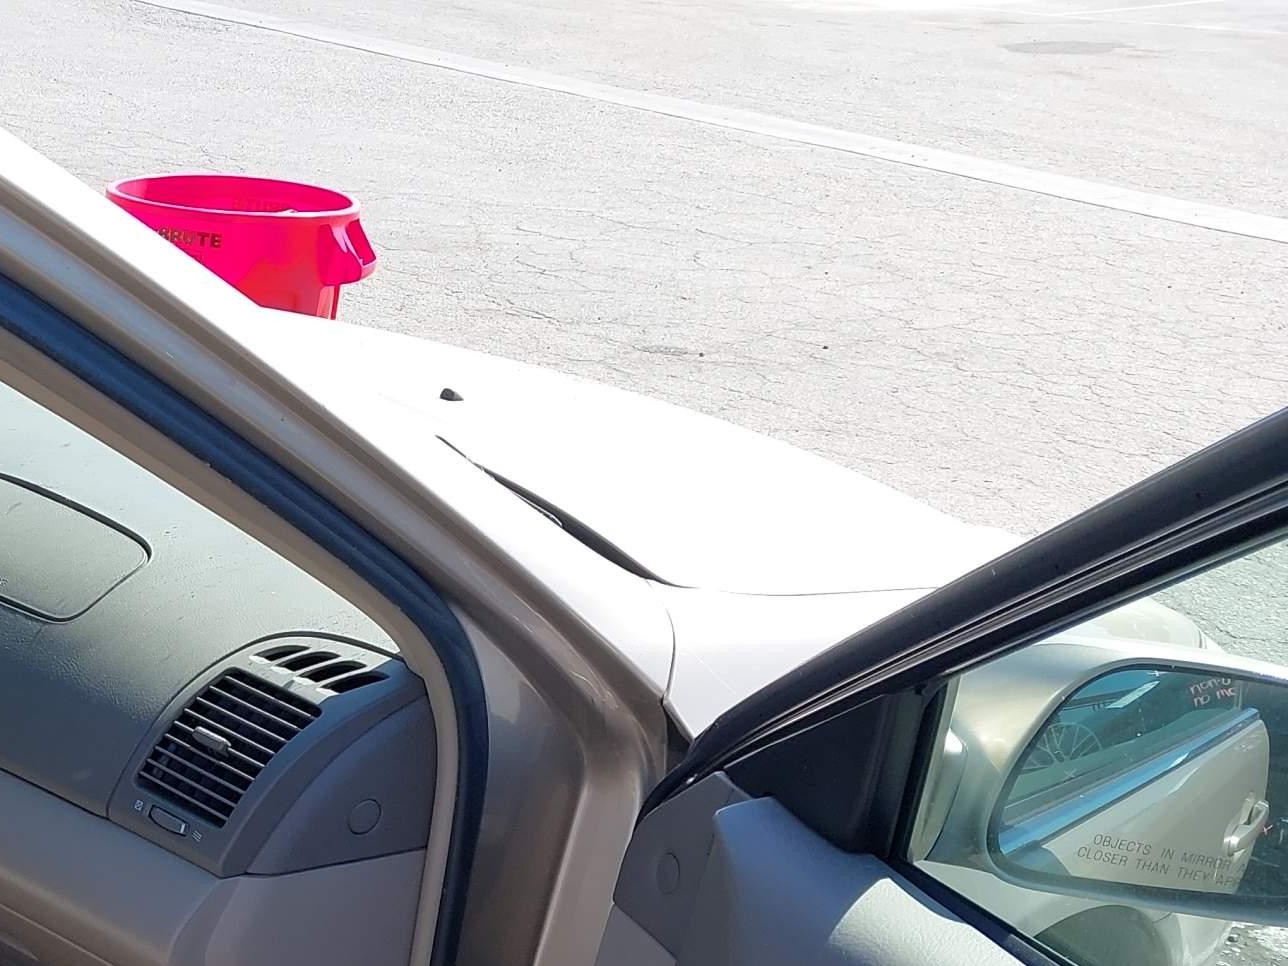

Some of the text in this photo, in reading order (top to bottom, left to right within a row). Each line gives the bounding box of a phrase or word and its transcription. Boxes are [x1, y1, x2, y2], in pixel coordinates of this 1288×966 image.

[158, 226, 222, 249] BRUTE
[1077, 846, 1129, 866] CLOSER
[1135, 858, 1170, 875] THAN
[1177, 866, 1213, 881] THEY
[1093, 833, 1152, 855] OBJECTS
[1161, 849, 1175, 860] IN
[1180, 852, 1231, 871] MIRROR
